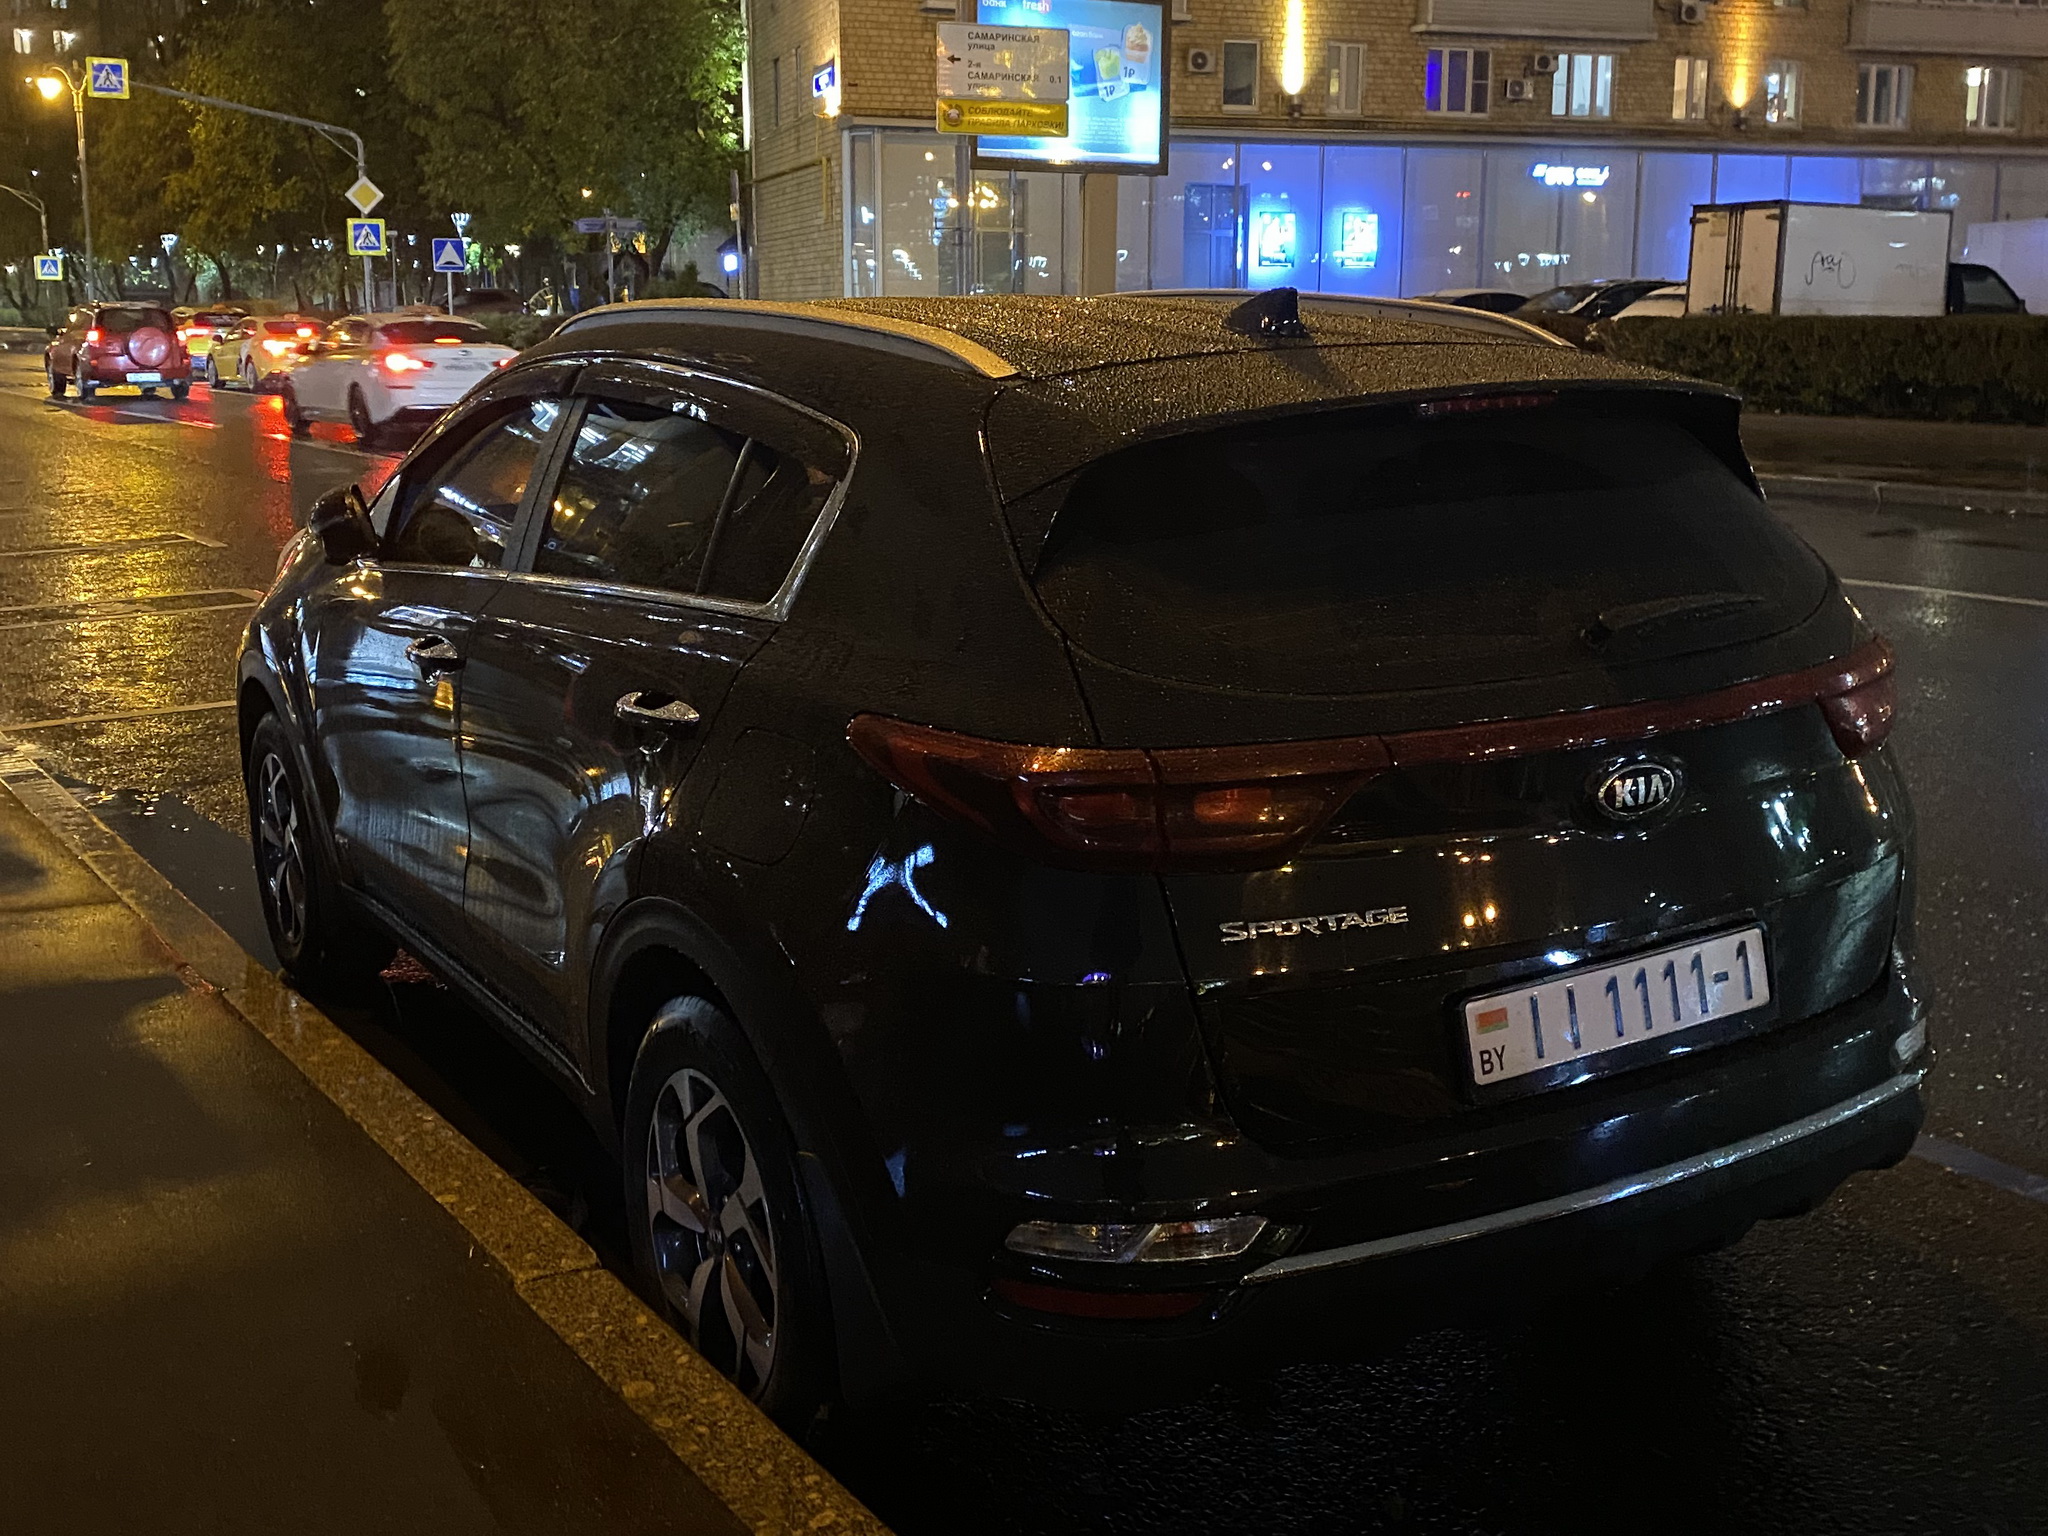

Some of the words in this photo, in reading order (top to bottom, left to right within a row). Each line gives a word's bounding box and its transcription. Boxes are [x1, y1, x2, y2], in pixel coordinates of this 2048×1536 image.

[967, 31, 1040, 43] САМАРИНСКАЯ
[967, 43, 995, 51] улица
[967, 60, 981, 68] 2-я
[1049, 75, 1062, 84] 0.1
[967, 106, 1033, 117] СОБЛЮДАЙТЕ
[1614, 773, 1665, 808] KIA
[1219, 906, 1410, 944] SPORTAGE
[1605, 940, 1754, 1038] 1111-1
[1479, 1045, 1506, 1076] BY
